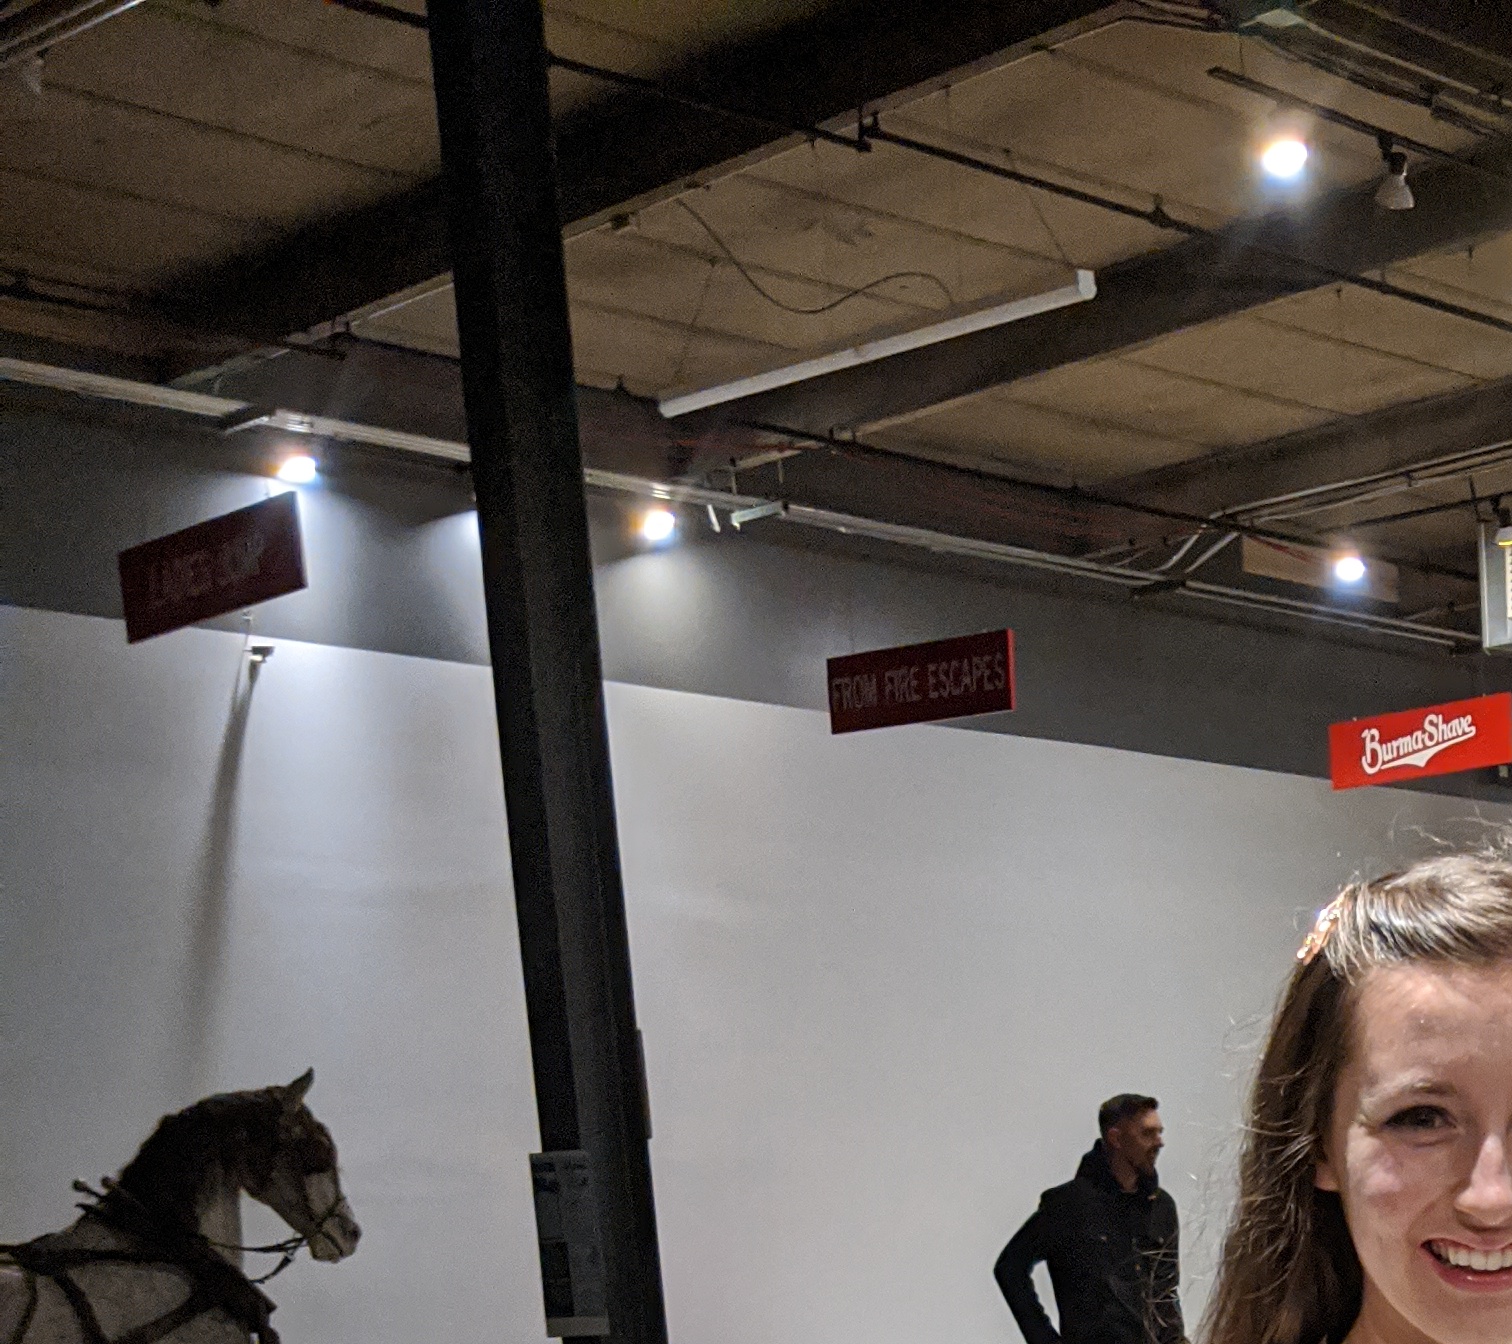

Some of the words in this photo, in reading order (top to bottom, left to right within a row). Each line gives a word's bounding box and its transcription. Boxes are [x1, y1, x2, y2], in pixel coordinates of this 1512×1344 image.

[832, 675, 877, 713] FROM
[885, 666, 922, 703] FIRE
[929, 652, 1005, 699] ESCAPES
[1361, 714, 1477, 775] Burma-Shave
